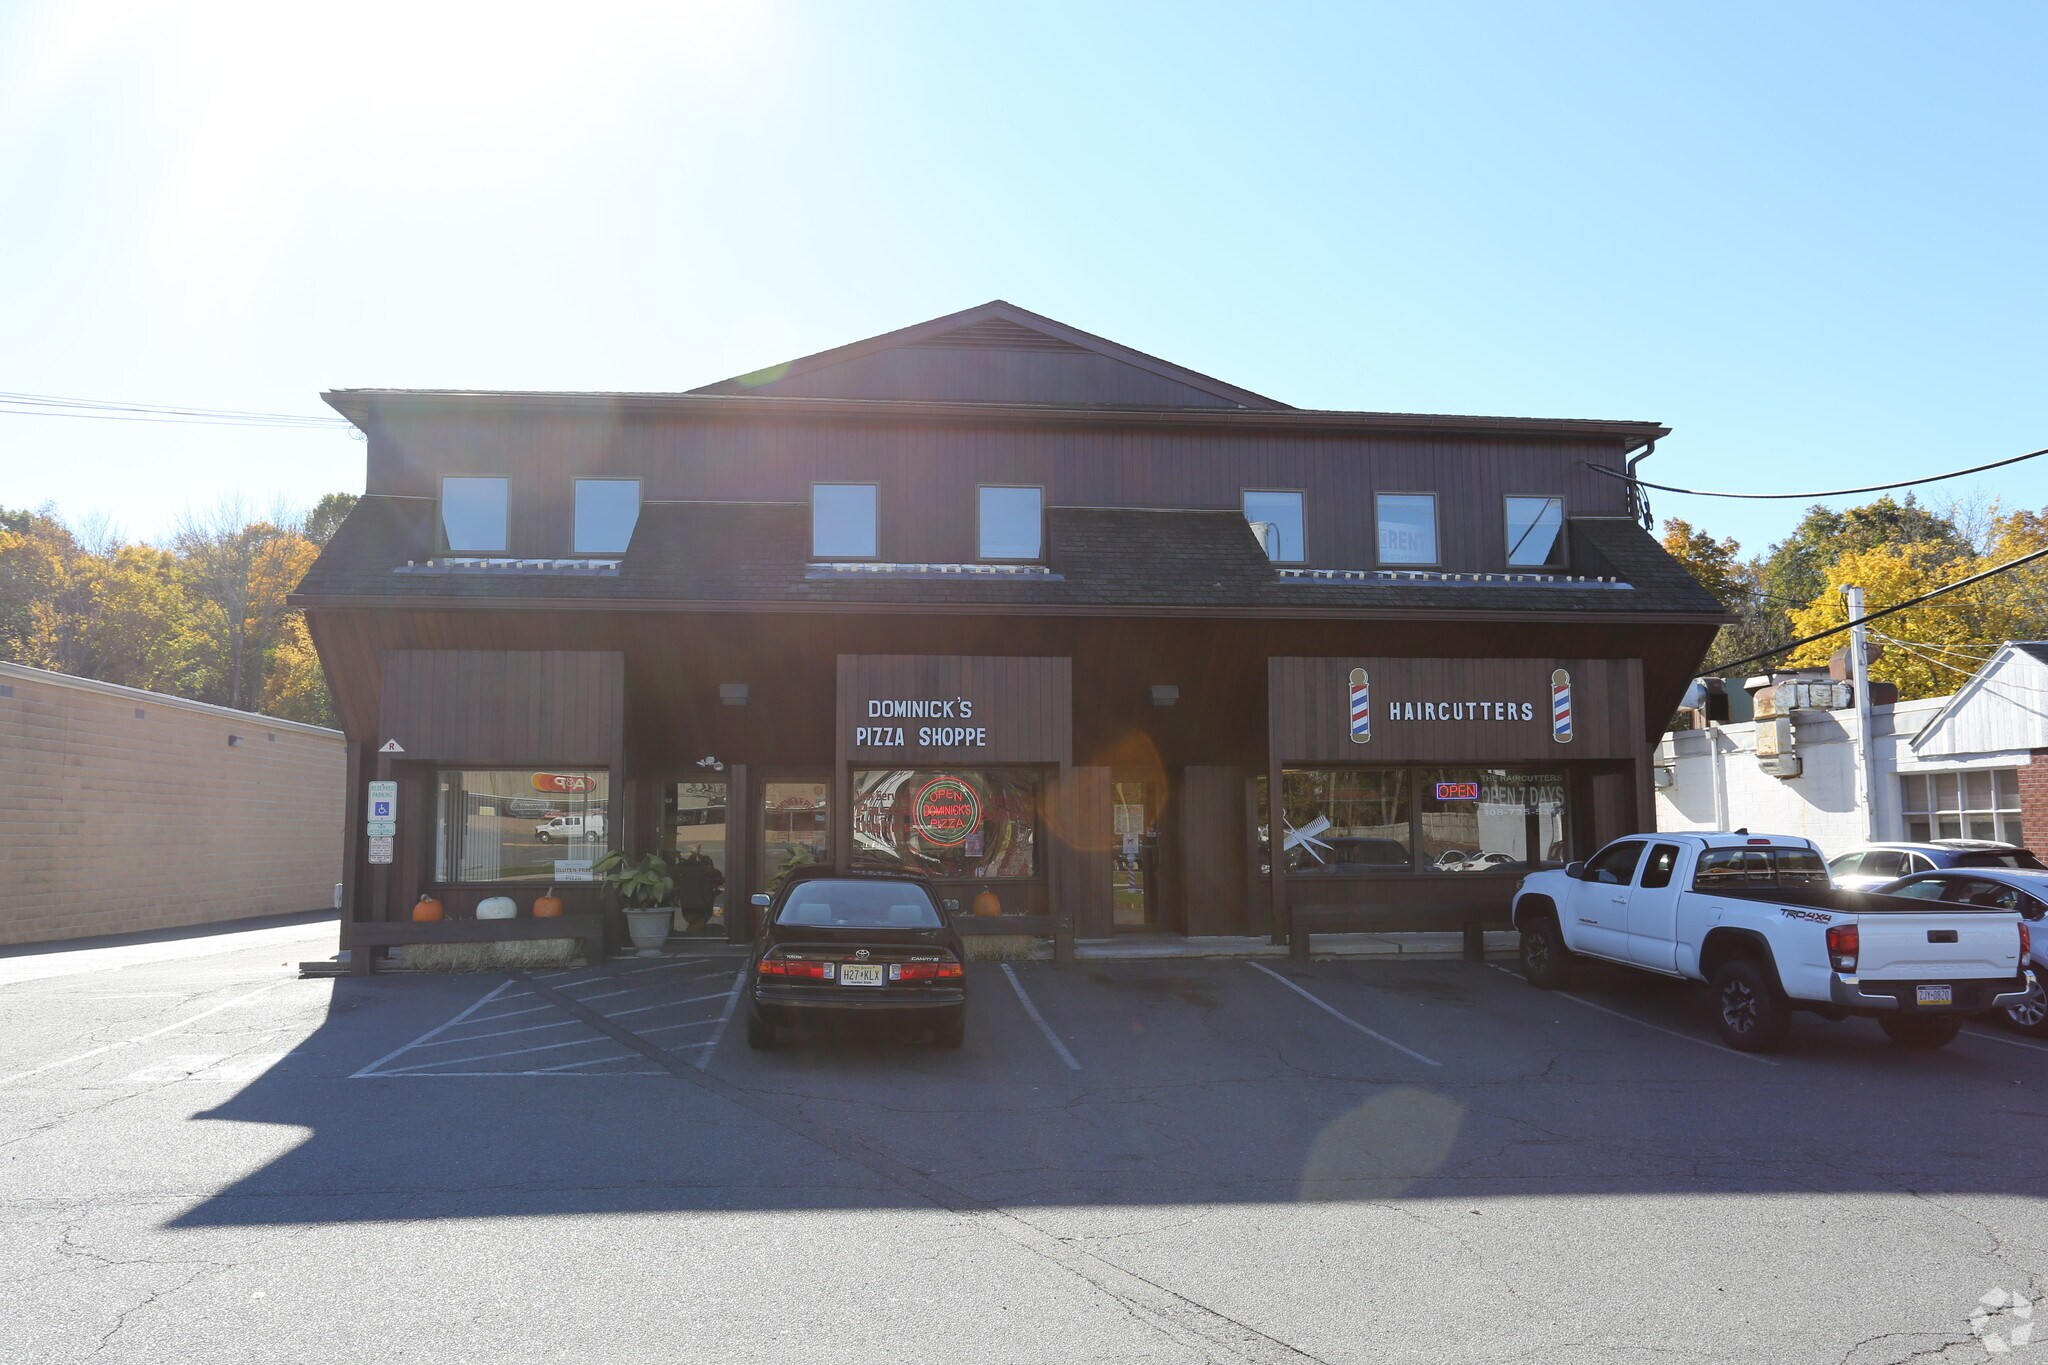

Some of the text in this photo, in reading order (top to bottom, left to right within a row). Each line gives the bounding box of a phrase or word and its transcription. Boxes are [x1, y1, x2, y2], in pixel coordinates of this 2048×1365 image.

[1388, 530, 1424, 552] RENT
[868, 696, 972, 719] DOMINICK'S
[1389, 702, 1534, 721] HAIRCUTTERS
[856, 727, 986, 746] PIZZA SHOPPE
[1481, 774, 1562, 783] THE HAIRCUTTERS
[929, 789, 963, 802] OPEN
[1438, 785, 1476, 799] OPEN
[1482, 786, 1564, 806] OPEN 7 DAYS
[923, 804, 972, 817] DOMINICK'S
[929, 818, 965, 829] PIZZA
[1780, 908, 1806, 920] TRD
